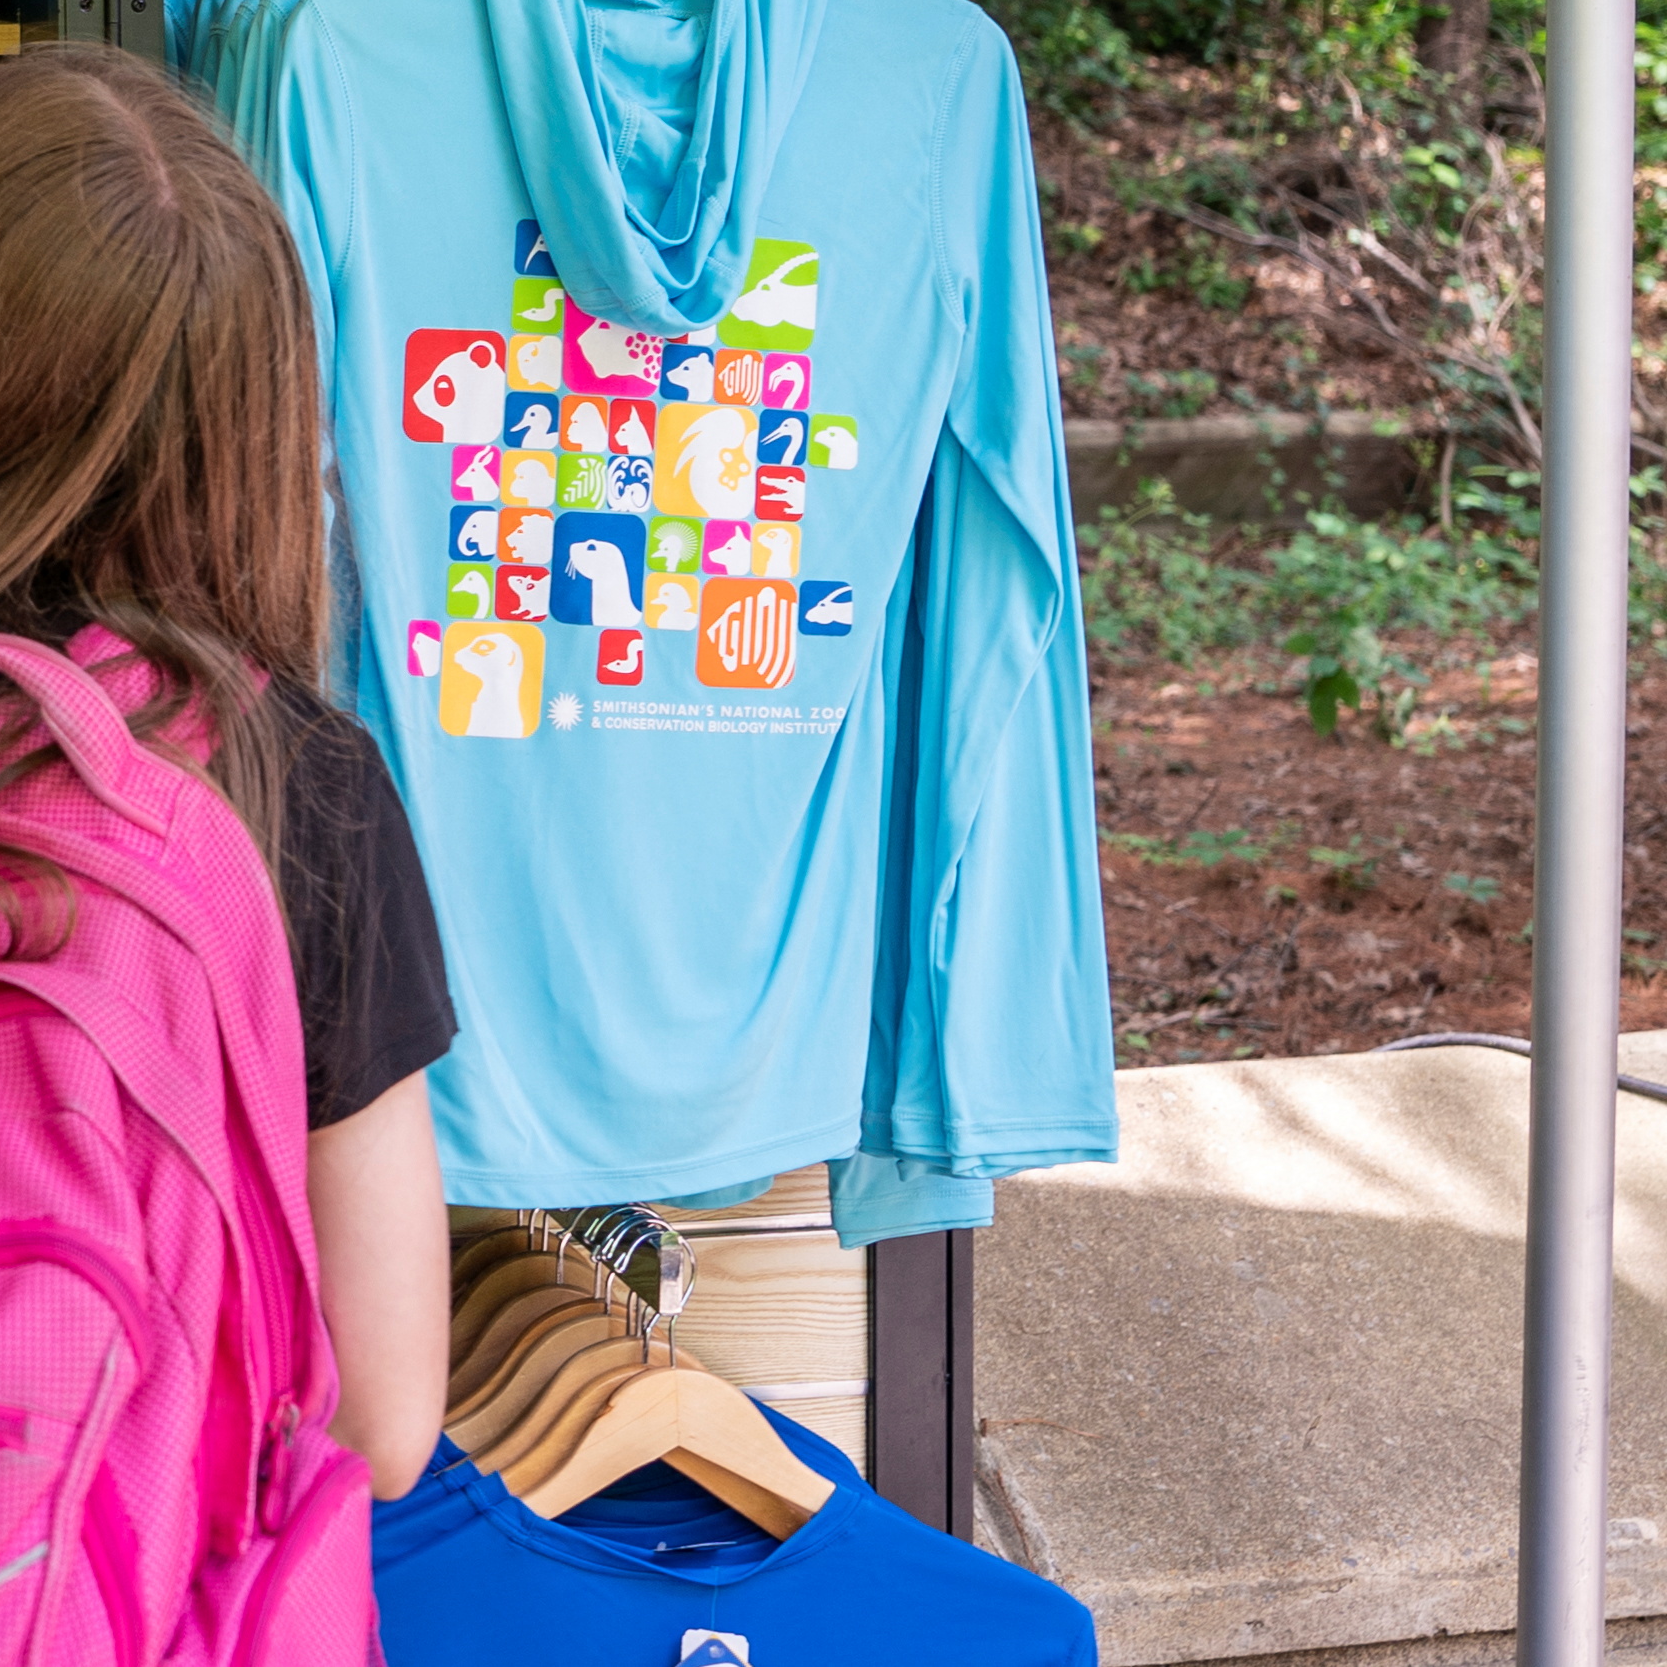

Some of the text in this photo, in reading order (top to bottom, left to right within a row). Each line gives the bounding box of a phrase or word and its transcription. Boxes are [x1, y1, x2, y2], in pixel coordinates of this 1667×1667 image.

[592, 700, 846, 720] SMITHSONIAN'S NATIONAL ZOO
[591, 717, 840, 735] & CONSERVATION BIOLOGY INSTITUT
